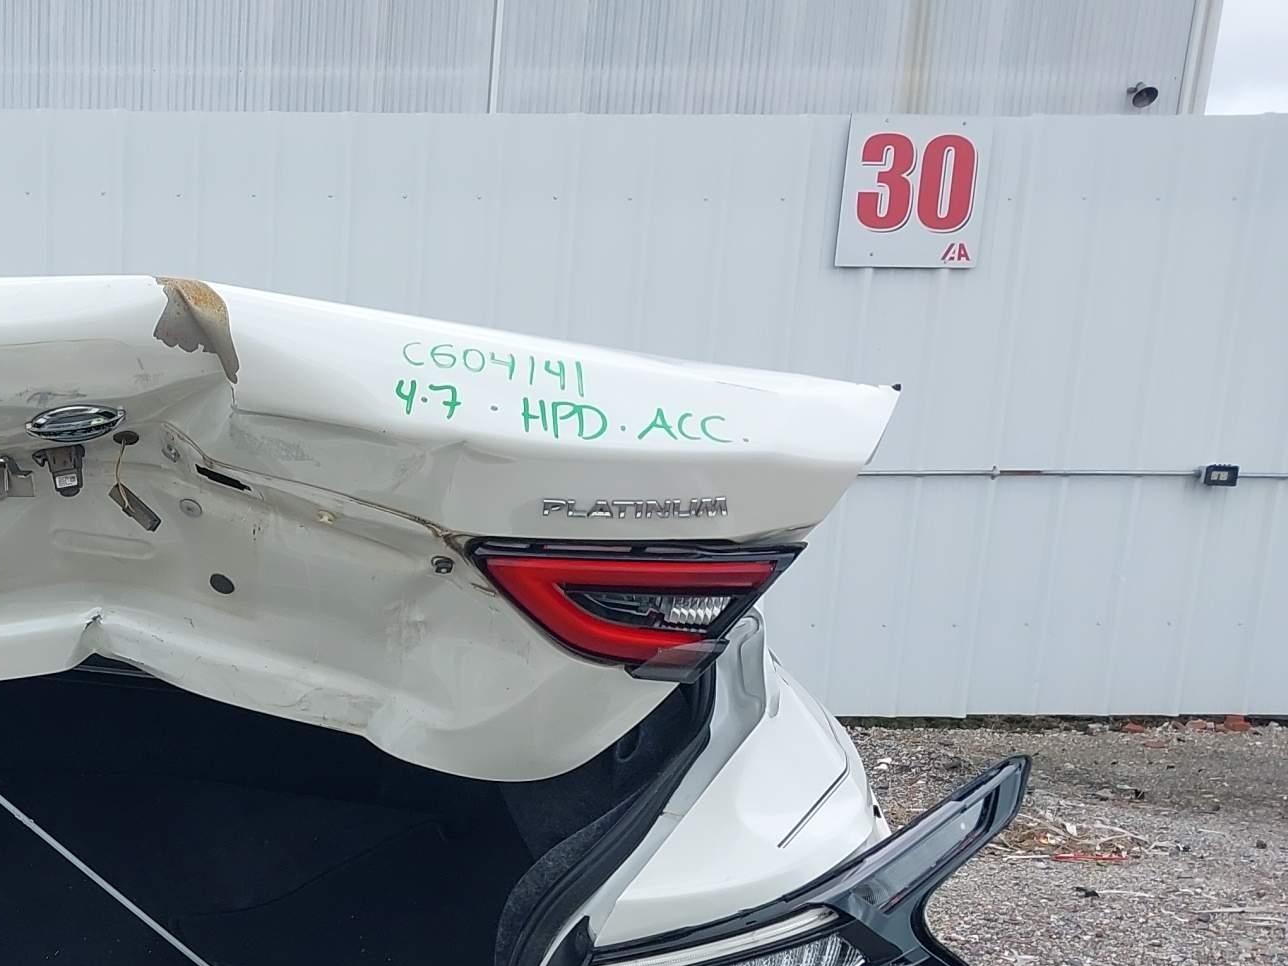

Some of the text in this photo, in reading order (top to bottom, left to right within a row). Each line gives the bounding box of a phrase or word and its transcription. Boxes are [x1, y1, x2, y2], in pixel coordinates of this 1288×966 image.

[856, 132, 977, 233] 30
[402, 341, 585, 397] C604141
[541, 496, 729, 519] PLATINUM
